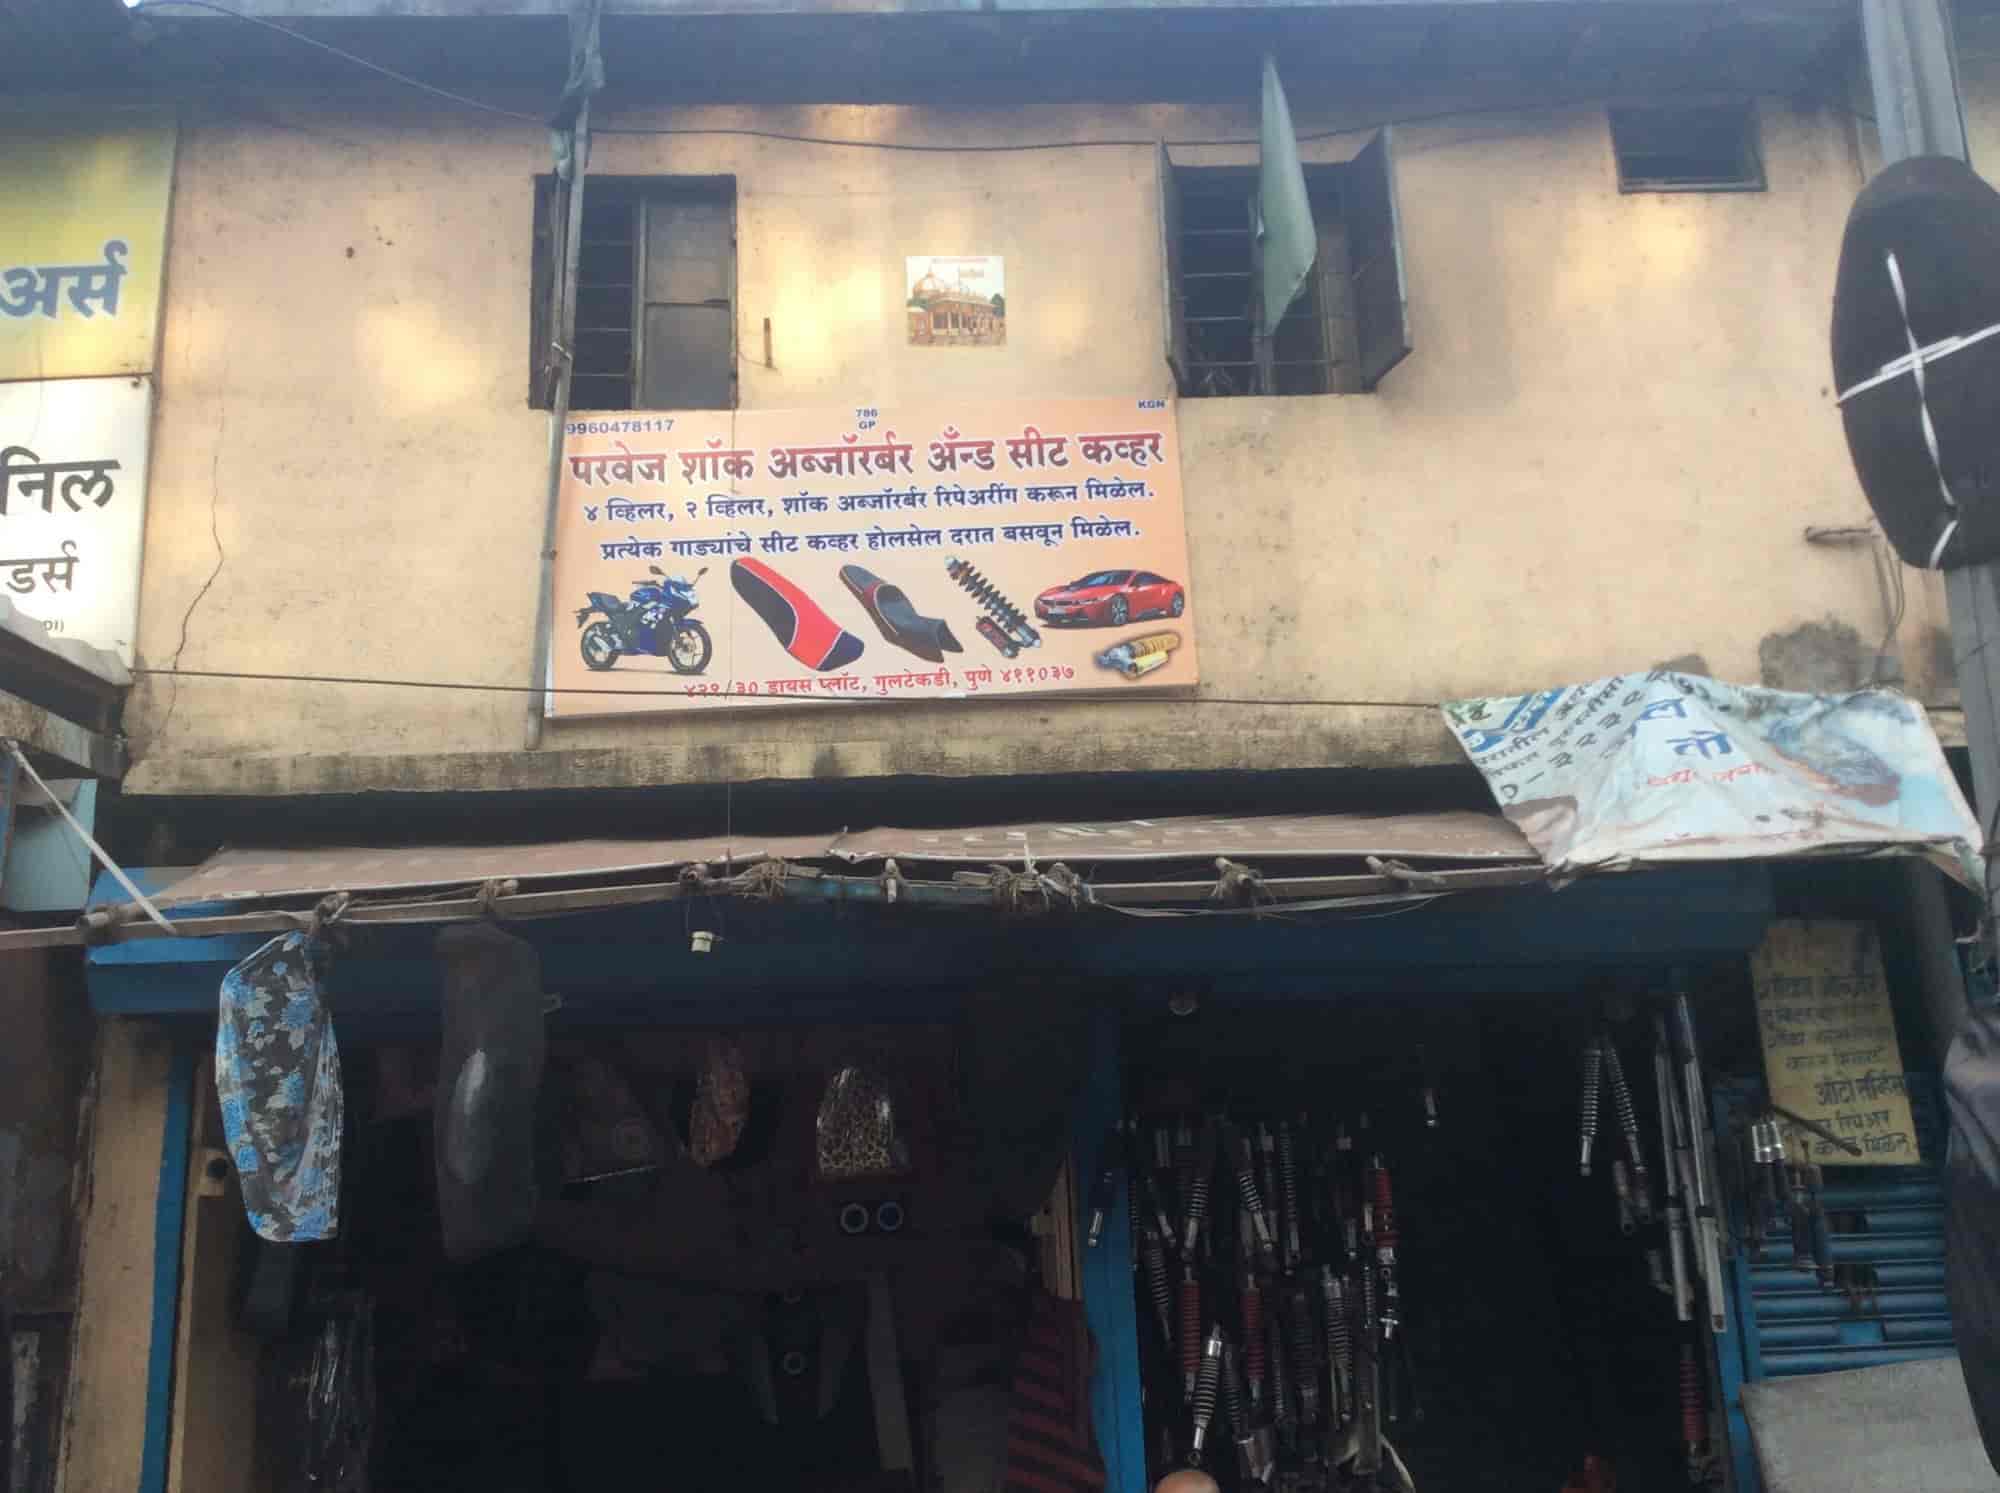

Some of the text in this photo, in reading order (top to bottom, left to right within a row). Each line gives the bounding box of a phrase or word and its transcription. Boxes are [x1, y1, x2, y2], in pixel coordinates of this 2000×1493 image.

[856, 408, 878, 417] 786
[1137, 400, 1165, 409] KGN
[566, 419, 675, 435] 9960478117
[858, 420, 876, 430] GP
[569, 439, 666, 486] परवेज
[679, 438, 755, 486] शॉक
[768, 431, 913, 480] अब्जॉरर्बर
[1006, 426, 1069, 470] सीट
[1079, 432, 1164, 467] कव्हर
[584, 504, 599, 522] ४
[606, 497, 674, 523] व्हिलर,
[685, 500, 697, 518] २
[707, 493, 774, 519] व्हिलर,
[783, 490, 828, 515] शॉक
[1026, 484, 1078, 504] करून
[1085, 476, 1155, 500] मिळेल.
[600, 515, 1141, 562] प्रत्येक गाड्यांचे सीट कव्हर होलसेल दरात बसवून मिळेल.
[873, 667, 957, 696] गुलटेकडी,
[964, 664, 992, 691] पुणे
[1000, 667, 1075, 684] ४११०३७
